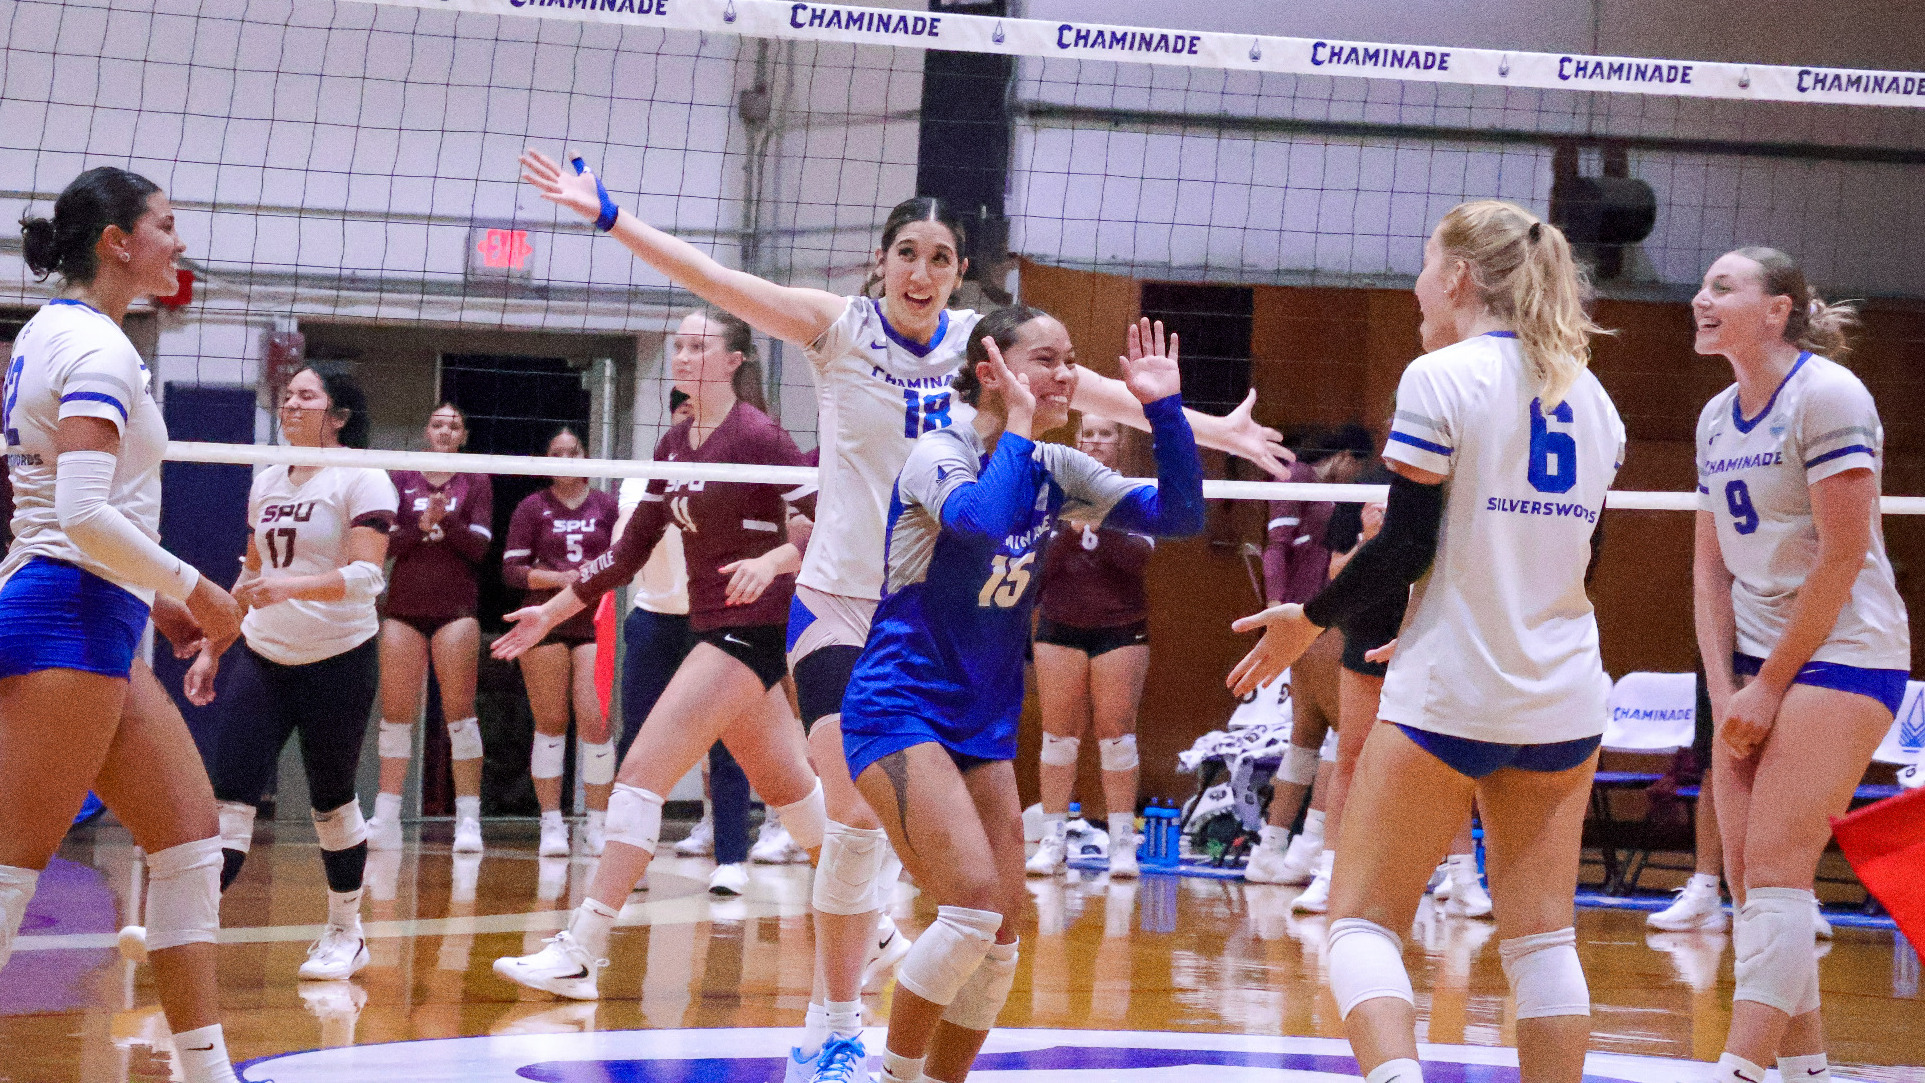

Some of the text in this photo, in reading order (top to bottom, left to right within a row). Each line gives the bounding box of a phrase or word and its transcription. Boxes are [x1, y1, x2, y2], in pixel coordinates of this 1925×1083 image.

[790, 4, 940, 38] CHAMINADE
[1057, 24, 1200, 56] CHAMINADE
[1311, 41, 1451, 72] CHAMINADE
[1558, 56, 1693, 85] CHAMINADE
[1797, 69, 1925, 96] CHAMINADE
[904, 389, 952, 439] 18
[1528, 396, 1577, 494] 6
[261, 502, 316, 523] SPU
[1725, 479, 1759, 535] 9
[553, 518, 596, 533] SPU
[265, 527, 297, 569] 17
[566, 534, 583, 562] 5
[978, 551, 1036, 607] 15
[1613, 706, 1693, 722] CHAMINADE
